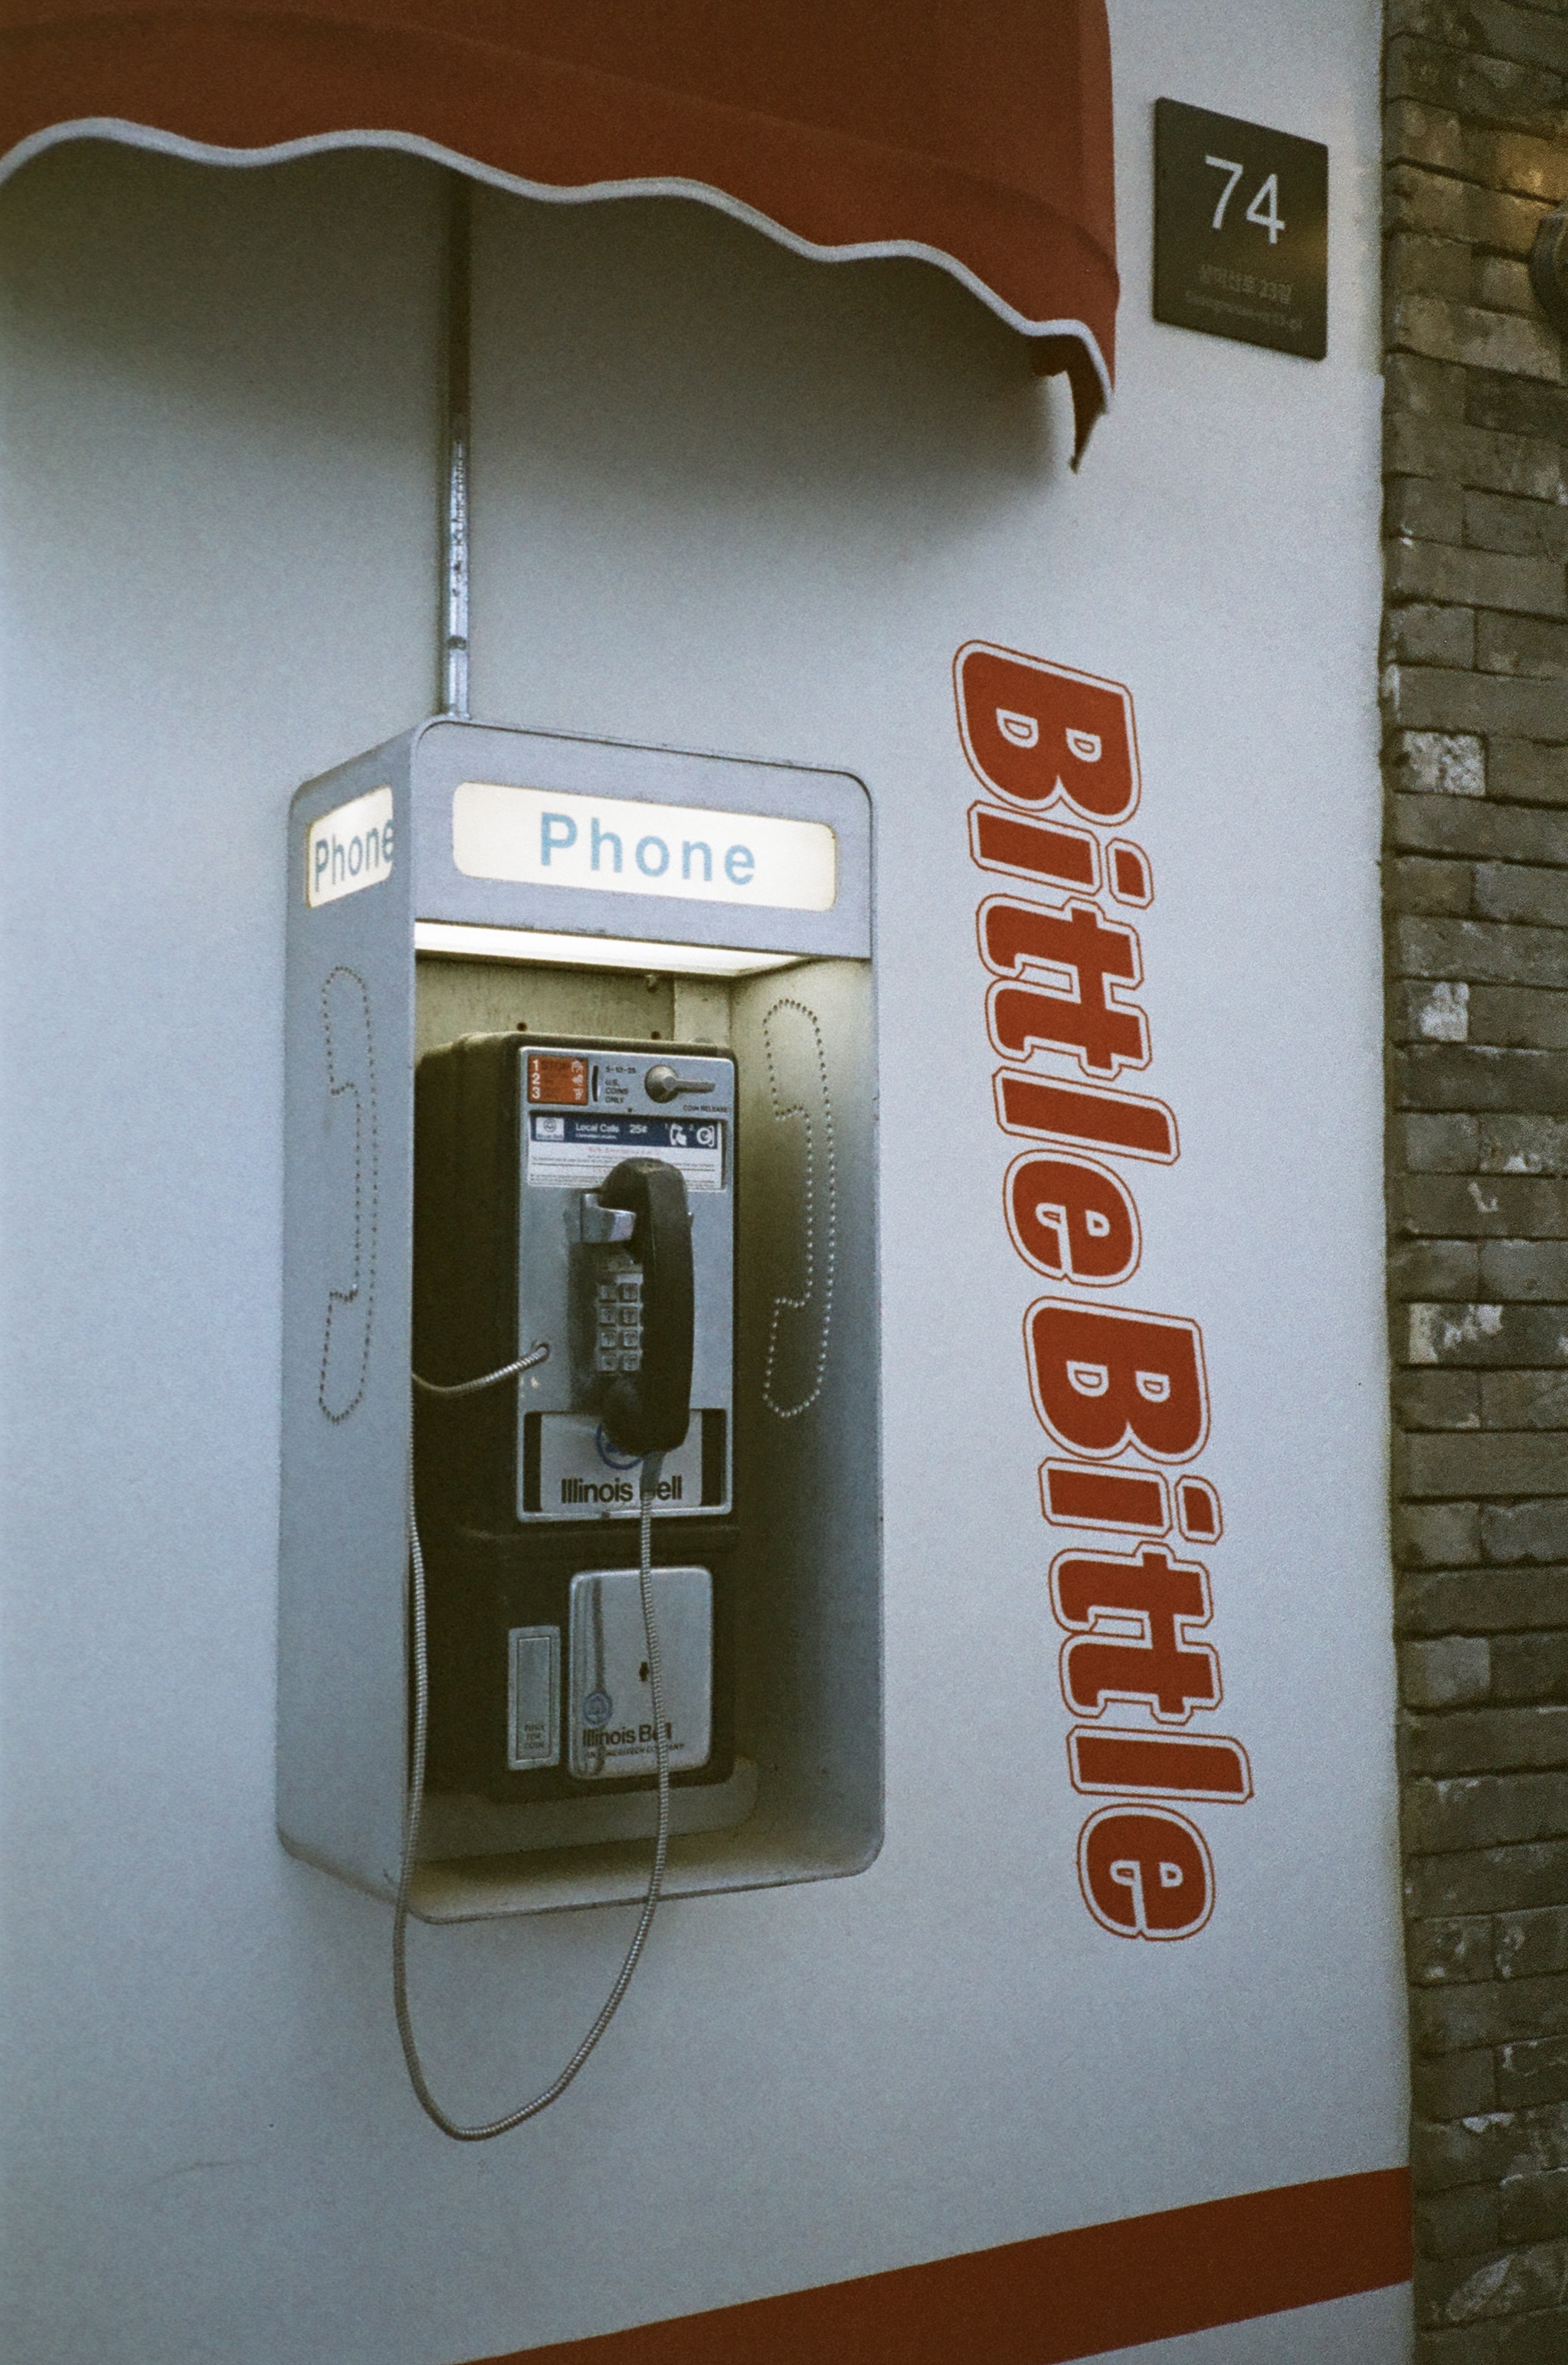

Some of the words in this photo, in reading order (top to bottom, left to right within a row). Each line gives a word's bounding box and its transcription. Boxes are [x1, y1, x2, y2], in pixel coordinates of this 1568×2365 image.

[1205, 155, 1285, 244] 74
[314, 820, 394, 893] Phone
[540, 811, 755, 886] Phone
[953, 640, 1180, 1288] Bittle
[532, 1060, 538, 1072] 1
[532, 1073, 540, 1085] 2
[532, 1087, 540, 1099] 3
[575, 1122, 597, 1132] Local
[600, 1123, 620, 1134] Calls
[561, 1477, 633, 1504] Illinois
[1023, 1295, 1253, 1941] Bittle
[582, 1726, 636, 1747] Illinois
[639, 1722, 671, 1743] Bel
